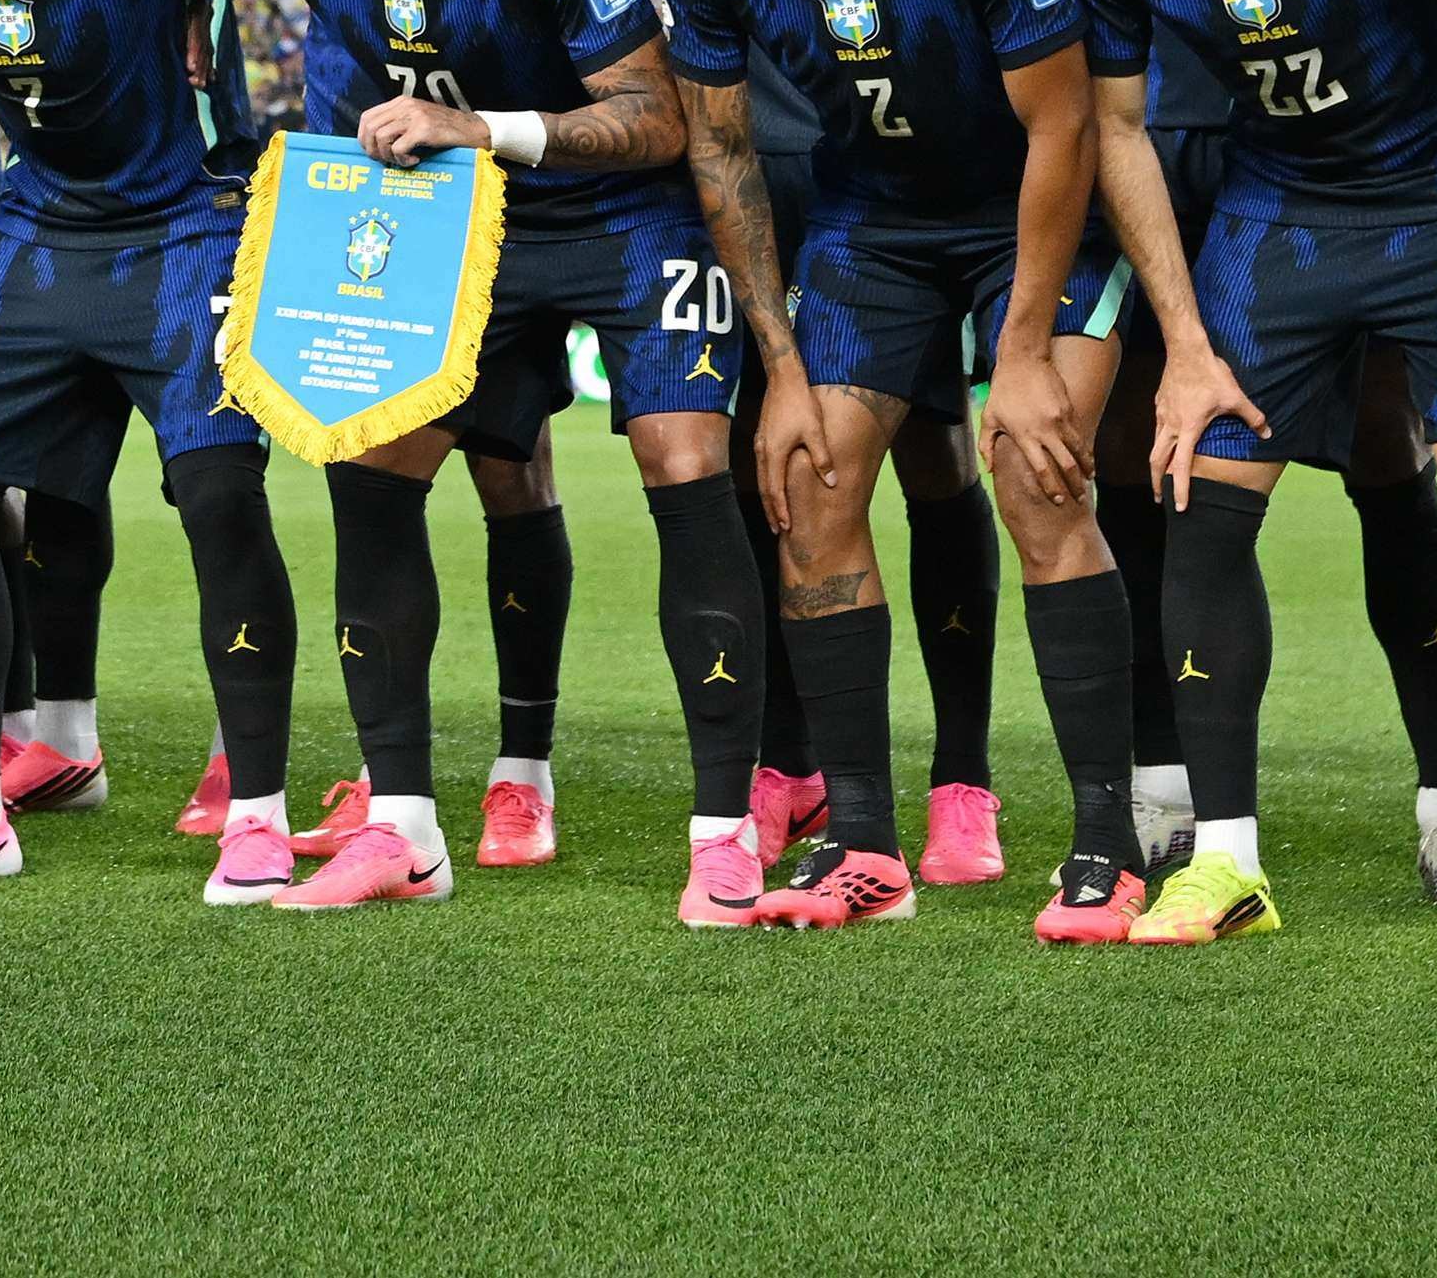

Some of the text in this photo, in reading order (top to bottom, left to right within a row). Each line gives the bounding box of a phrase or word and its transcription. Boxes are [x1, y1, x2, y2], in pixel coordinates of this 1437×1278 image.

[840, 6, 861, 18] CBF
[1238, 23, 1299, 45] BRASIL
[389, 37, 438, 53] BRASIL
[836, 46, 893, 61] BRASIL
[1240, 46, 1350, 116] 22
[7, 77, 43, 128] 7
[854, 77, 915, 137] 2
[307, 161, 371, 193] CBF
[336, 283, 385, 300] BRASIL
[661, 260, 734, 336] 20
[312, 337, 346, 351] BRASIL
[300, 375, 344, 390] ESTADOS
